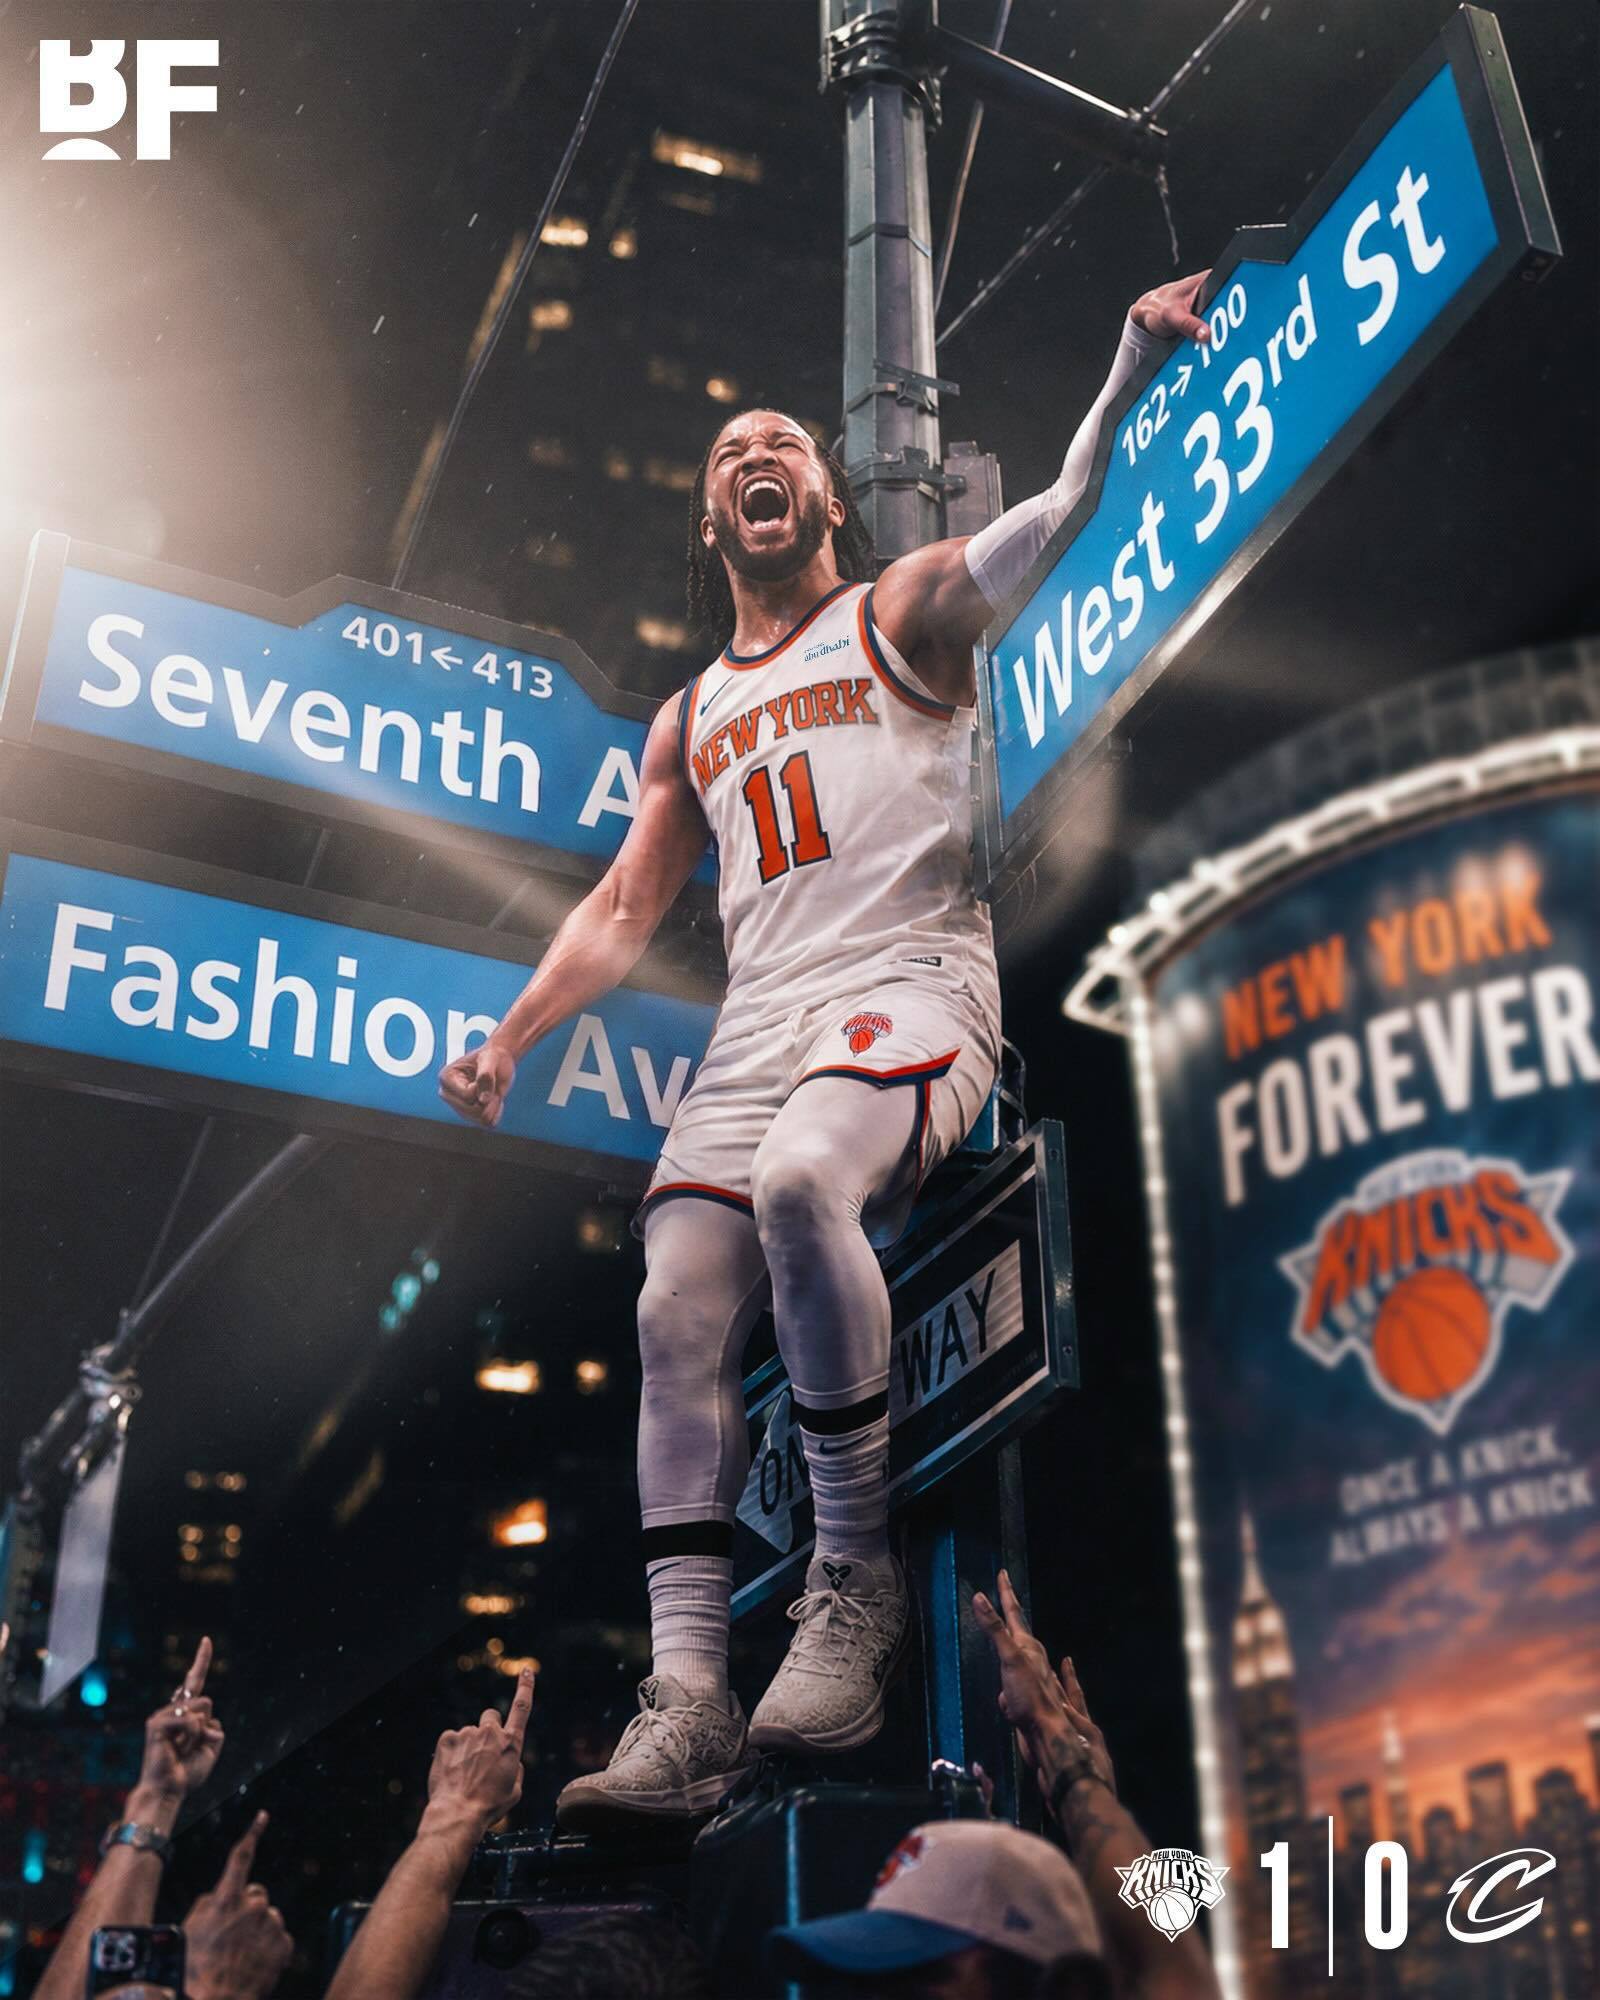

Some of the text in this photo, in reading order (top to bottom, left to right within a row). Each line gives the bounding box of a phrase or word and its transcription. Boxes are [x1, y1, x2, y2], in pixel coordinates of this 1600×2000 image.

[1122, 283, 1248, 467] 162 100
[1013, 165, 1447, 749] West 33rd St
[79, 613, 641, 828] Seventh A
[342, 616, 554, 699] 401 413
[692, 678, 881, 796] NEW YORK
[742, 750, 832, 886] 11
[1222, 866, 1554, 1063] NEW YORK
[547, 1013, 691, 1129] Av
[1216, 963, 1600, 1207] FOREVER
[1303, 1167, 1563, 1336] KNICKS
[901, 1269, 996, 1407] WAY
[760, 1435, 809, 1515] ON
[1330, 1501, 1449, 1568] ALWAYS
[1459, 1493, 1483, 1534] A
[1341, 1457, 1418, 1515] ONCE
[1431, 1450, 1450, 1488] A
